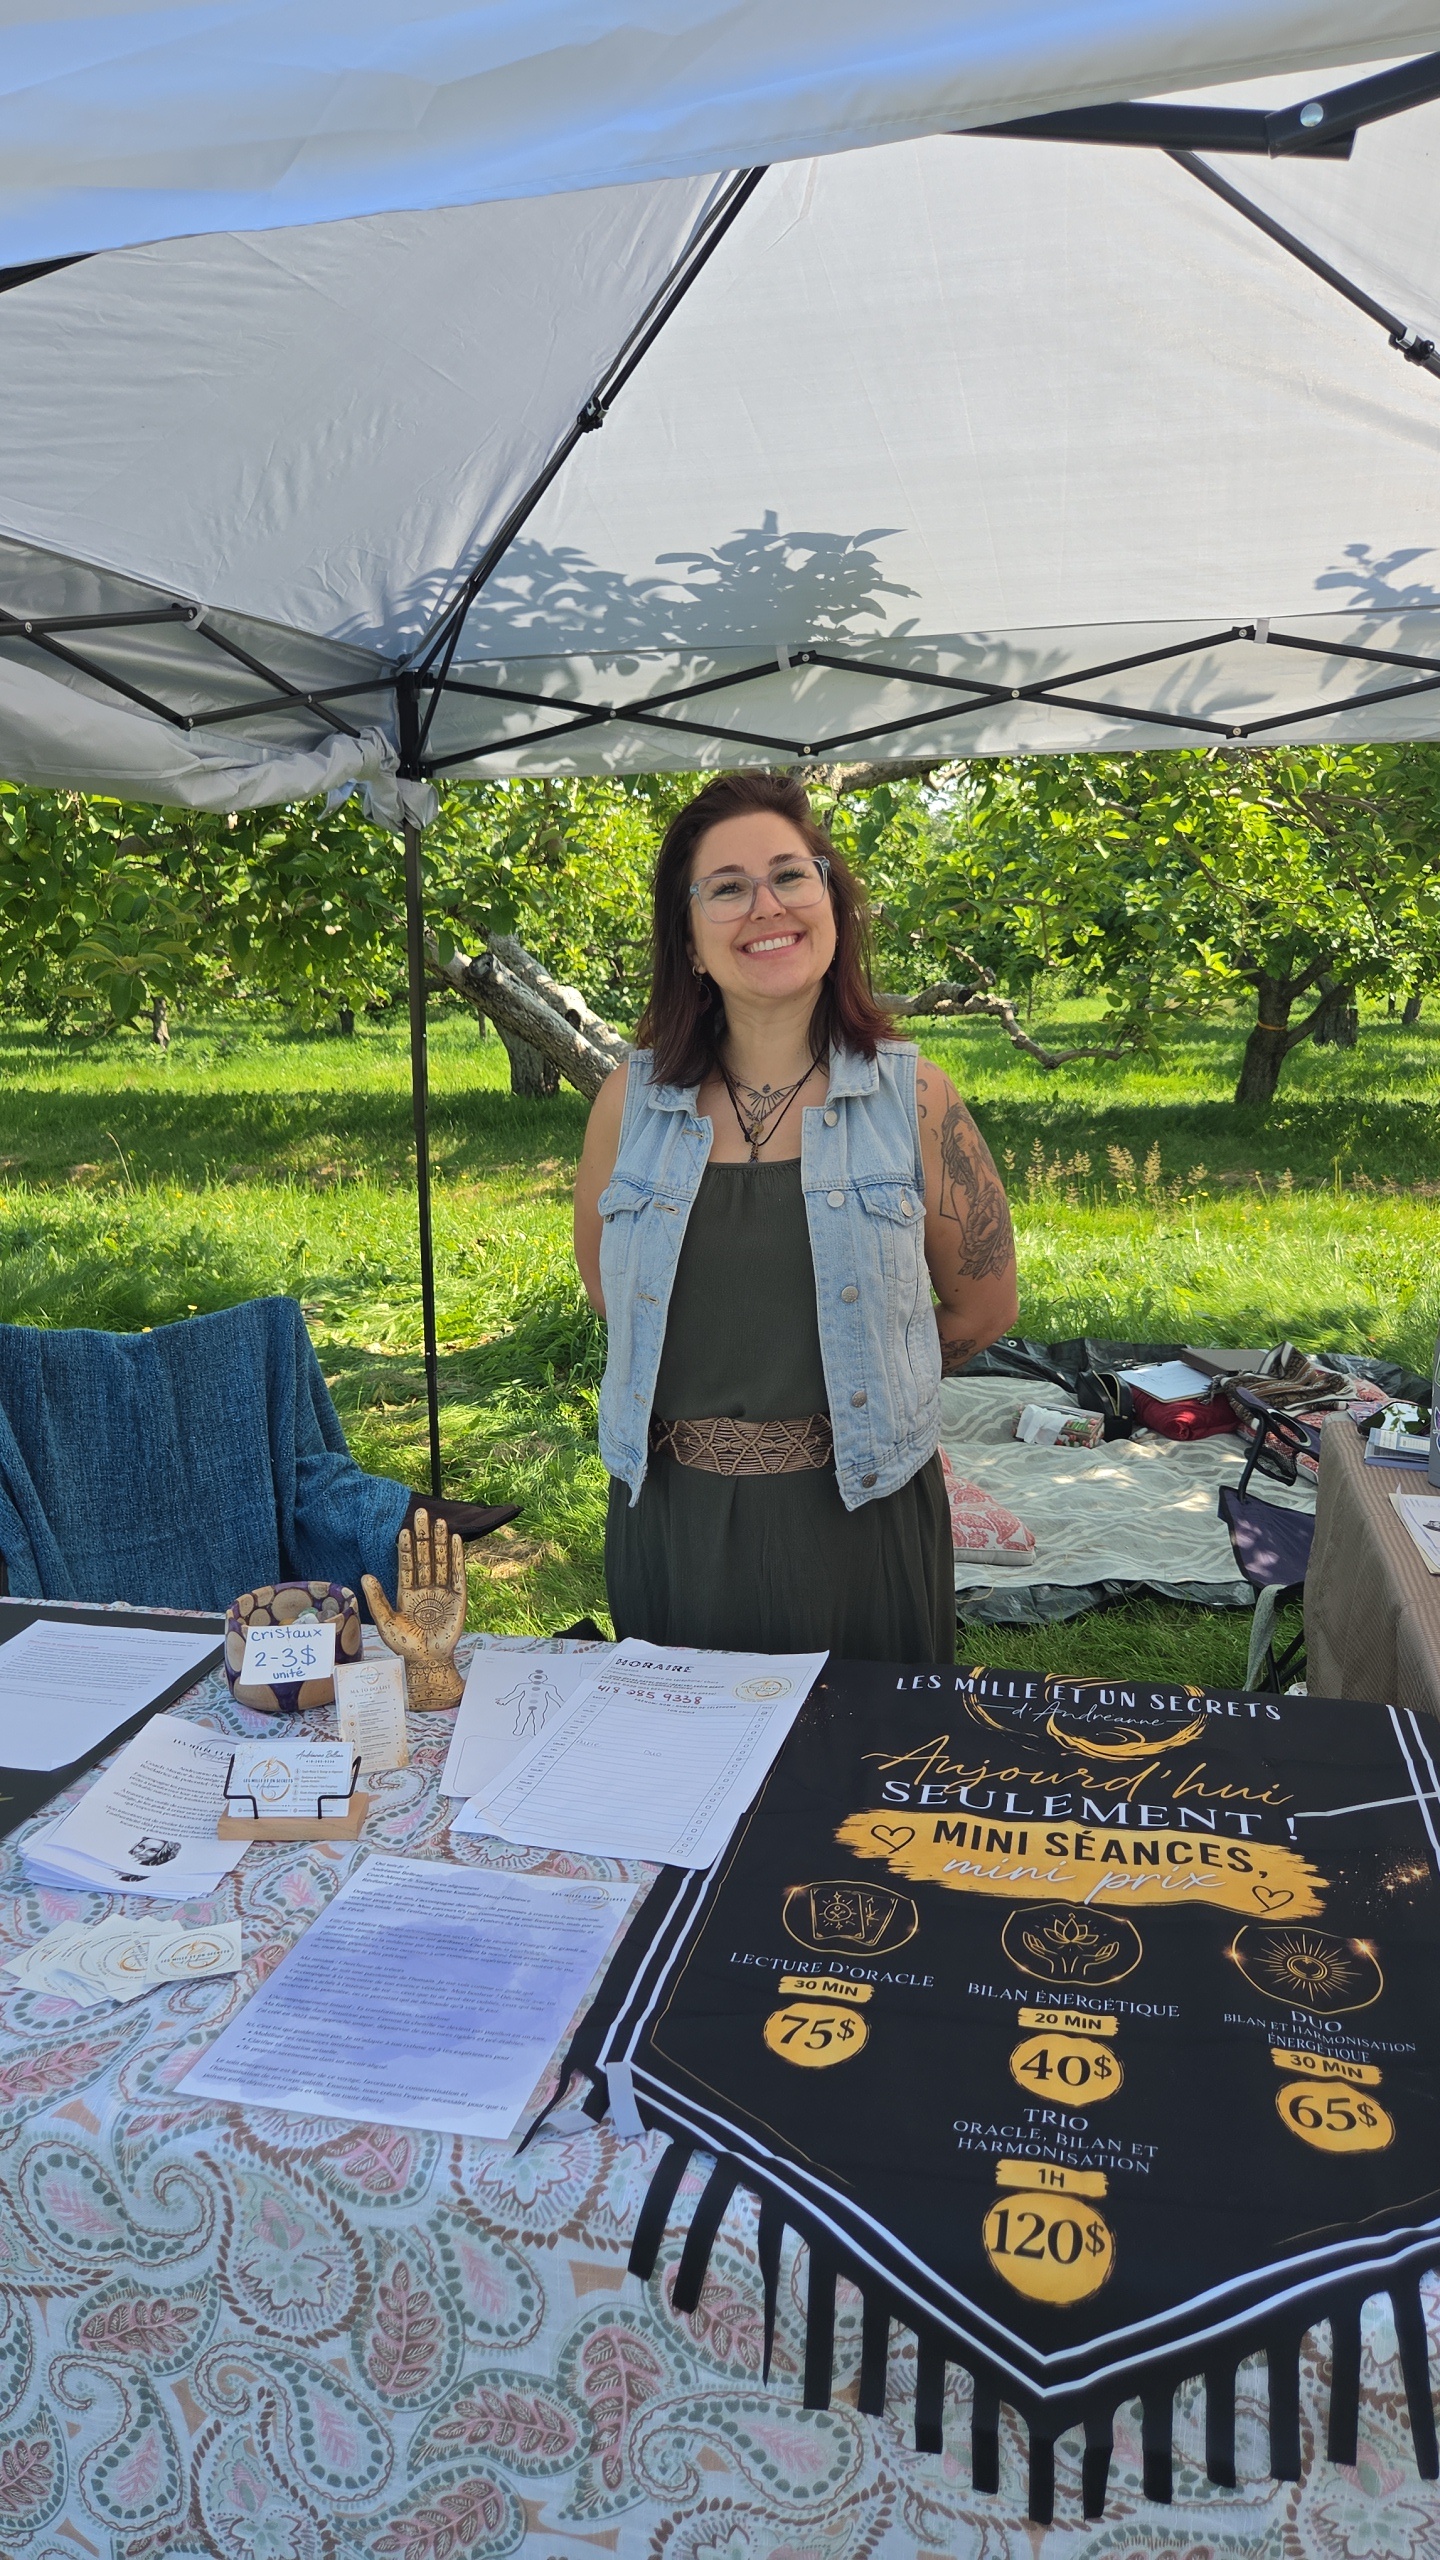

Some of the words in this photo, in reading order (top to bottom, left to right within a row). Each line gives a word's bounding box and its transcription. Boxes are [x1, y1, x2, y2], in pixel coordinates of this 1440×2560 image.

[251, 1627, 322, 1641] cristaux
[272, 1666, 305, 1680] unité
[615, 1658, 695, 1674] HORAIRE
[663, 1693, 703, 1705] 9338
[896, 1674, 941, 1691] LES
[955, 1677, 1038, 1700] MILLE
[1053, 1684, 1085, 1704] ET
[1101, 1689, 1136, 1708] UN
[1150, 1693, 1282, 1721] SECRETS
[862, 1734, 1295, 1806] Aujourd'hui
[881, 1780, 1262, 1836] SEULEMENT
[1286, 1816, 1299, 1841] !
[933, 1820, 1028, 1857] MINI
[1045, 1829, 1268, 1879] SÉANCES,
[943, 1857, 1076, 1883] mini
[1083, 1863, 1227, 1905] prix
[730, 1952, 822, 1973] LECTURE
[828, 1961, 935, 1987] D'ORACLE
[794, 1980, 817, 1990] 30
[822, 1981, 859, 1997] MIN
[968, 1982, 1028, 2003] BILAN
[1036, 1990, 1180, 2018] ÉNERGÉTIQUE
[780, 2014, 856, 2050] 75$
[1035, 2013, 1058, 2025] 20
[1064, 2015, 1102, 2030] MIN
[1224, 2013, 1266, 2028] BILAN
[1270, 2021, 1288, 2032] ET
[1292, 2024, 1416, 2052] HARMONISATION
[1291, 2010, 1342, 2032] DUO
[1268, 2032, 1371, 2064] ÉNERGÉTIQUE
[1020, 2049, 1113, 2087] 40$
[1290, 2054, 1316, 2070] 30
[1322, 2060, 1363, 2079] MIN
[1024, 2108, 1089, 2132] TRIO
[1289, 2095, 1378, 2132] 65$
[953, 2120, 1047, 2141] ORACLE,
[1056, 2132, 1122, 2152] BILAN
[1132, 2142, 1159, 2158] ET
[958, 2137, 1151, 2174] HARMONISATION
[1038, 2168, 1065, 2188] 1H
[991, 2208, 1106, 2265] 120$
